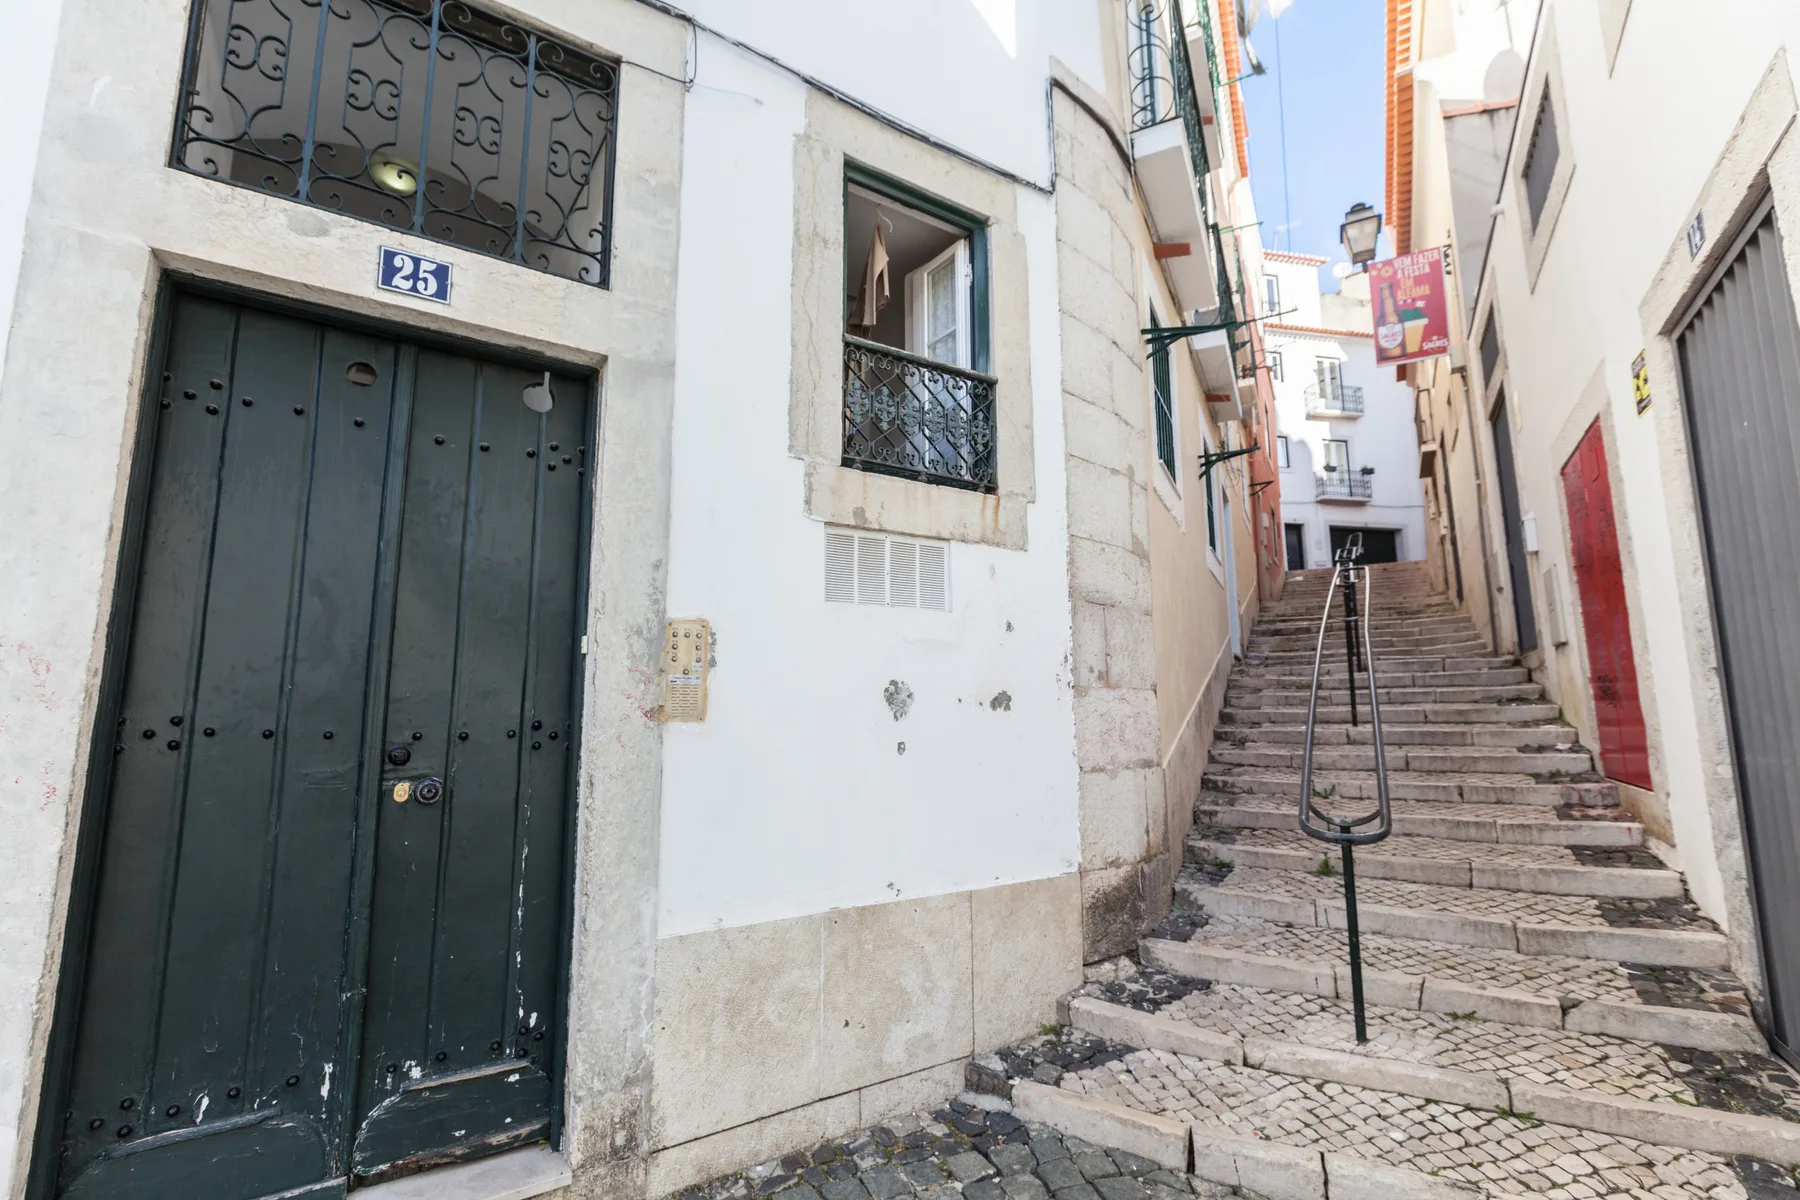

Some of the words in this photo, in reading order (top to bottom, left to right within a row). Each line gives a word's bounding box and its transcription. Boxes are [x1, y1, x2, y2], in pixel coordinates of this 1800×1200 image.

[1393, 256, 1411, 269] VEM
[1413, 249, 1440, 265] FAZER
[391, 254, 438, 295] 25
[1404, 263, 1430, 278] FESTA
[1400, 277, 1414, 289] EM
[1397, 284, 1431, 300] ALFAMA
[1422, 338, 1449, 350] SAGRES
